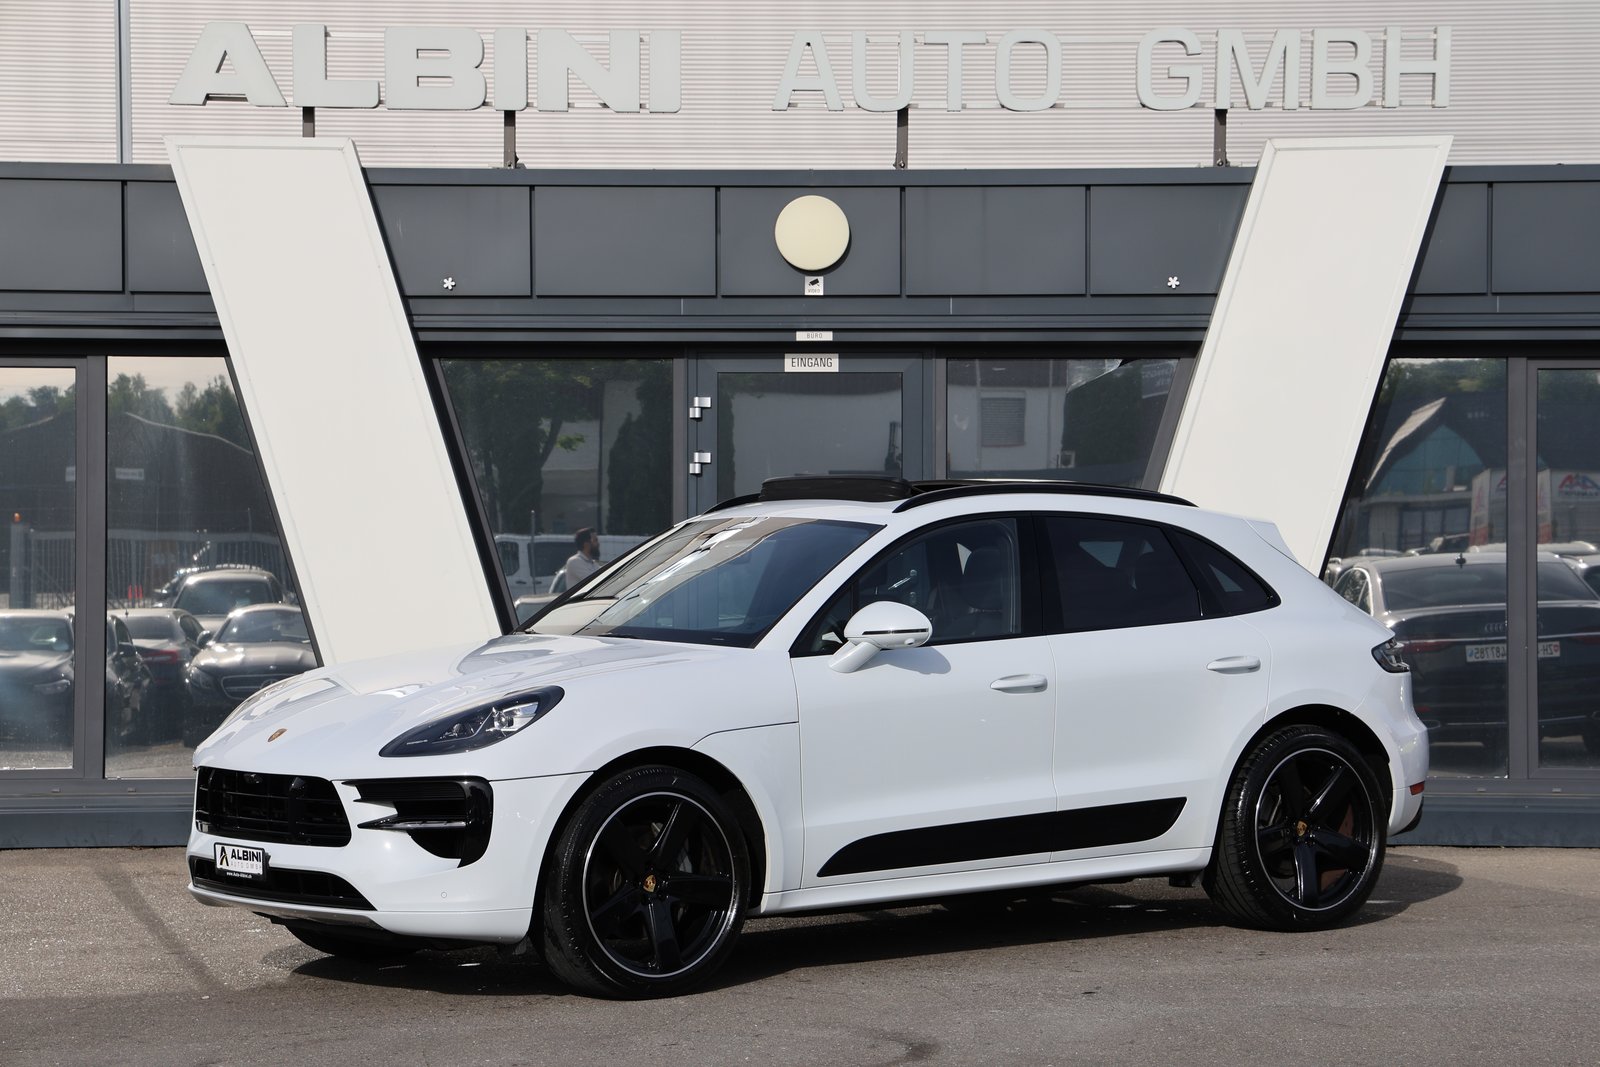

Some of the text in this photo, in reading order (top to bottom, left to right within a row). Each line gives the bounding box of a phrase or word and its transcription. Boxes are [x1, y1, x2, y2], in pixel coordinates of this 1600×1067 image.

[168, 22, 1452, 113] ALBINI AUTO GMBH
[791, 357, 833, 367] EINGANG
[231, 849, 261, 862] ALBINI
